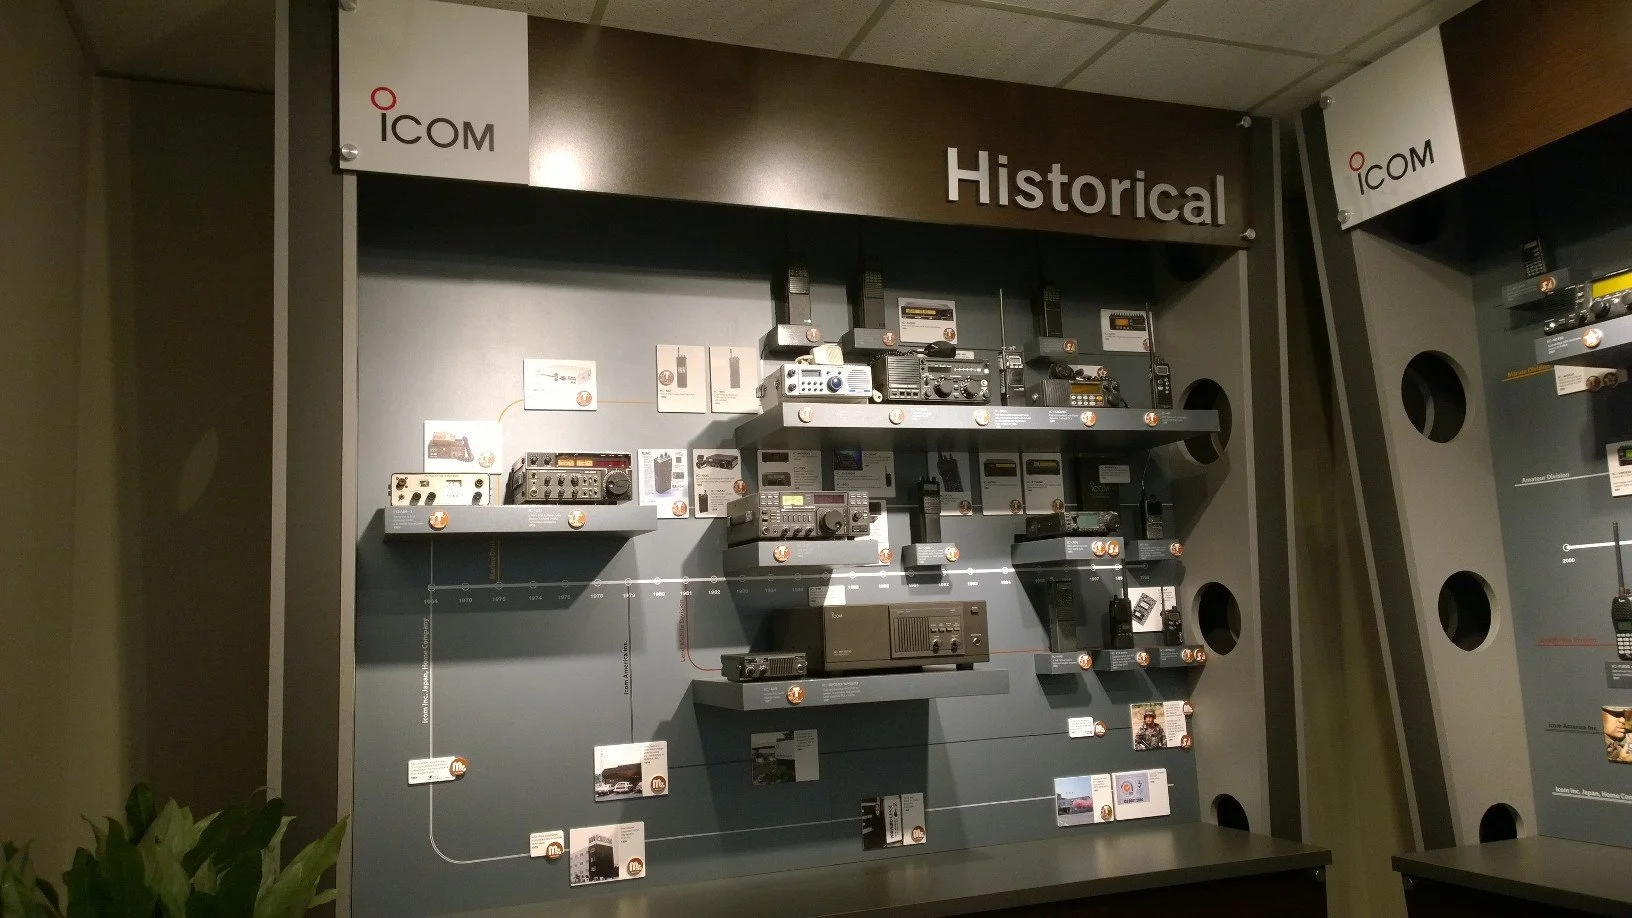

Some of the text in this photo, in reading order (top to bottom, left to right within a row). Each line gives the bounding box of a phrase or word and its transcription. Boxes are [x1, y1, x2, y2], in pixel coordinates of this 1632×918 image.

[946, 146, 1227, 226] Historical
[1522, 472, 1570, 484] Amateur Division
[422, 618, 431, 650] Company
[422, 651, 430, 670] Home
[422, 693, 430, 706] Inc.
[422, 707, 430, 724] Icom
[1555, 786, 1570, 794] Icom
[1570, 787, 1581, 795] Inc.
[1601, 791, 1620, 799] Home
